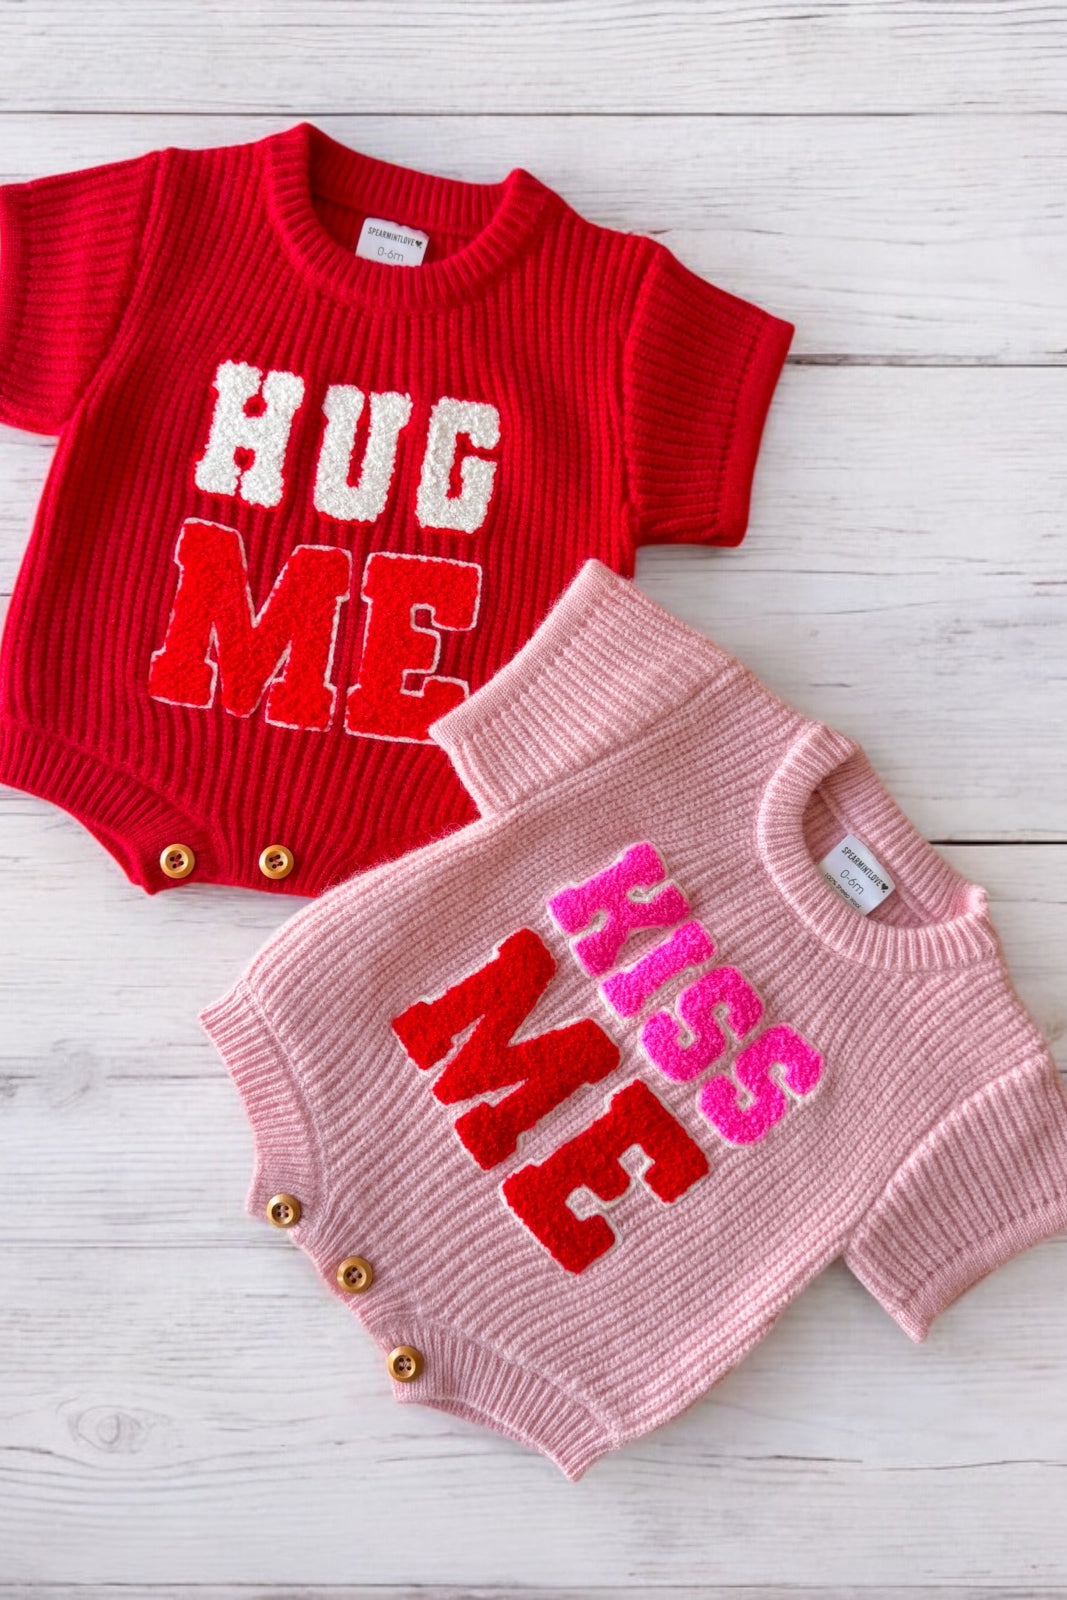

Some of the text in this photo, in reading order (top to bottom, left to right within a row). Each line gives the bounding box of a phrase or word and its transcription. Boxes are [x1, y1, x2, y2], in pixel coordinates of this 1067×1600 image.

[367, 226, 415, 247] SPEARMINTLOVE
[377, 246, 405, 262] 0-6m
[195, 359, 501, 534] HUG
[149, 517, 482, 745] ME
[840, 869, 864, 895] 0-6m
[841, 846, 883, 887] SPEARMINTLOVE
[547, 841, 824, 1146] KISS
[390, 927, 711, 1275] ME
